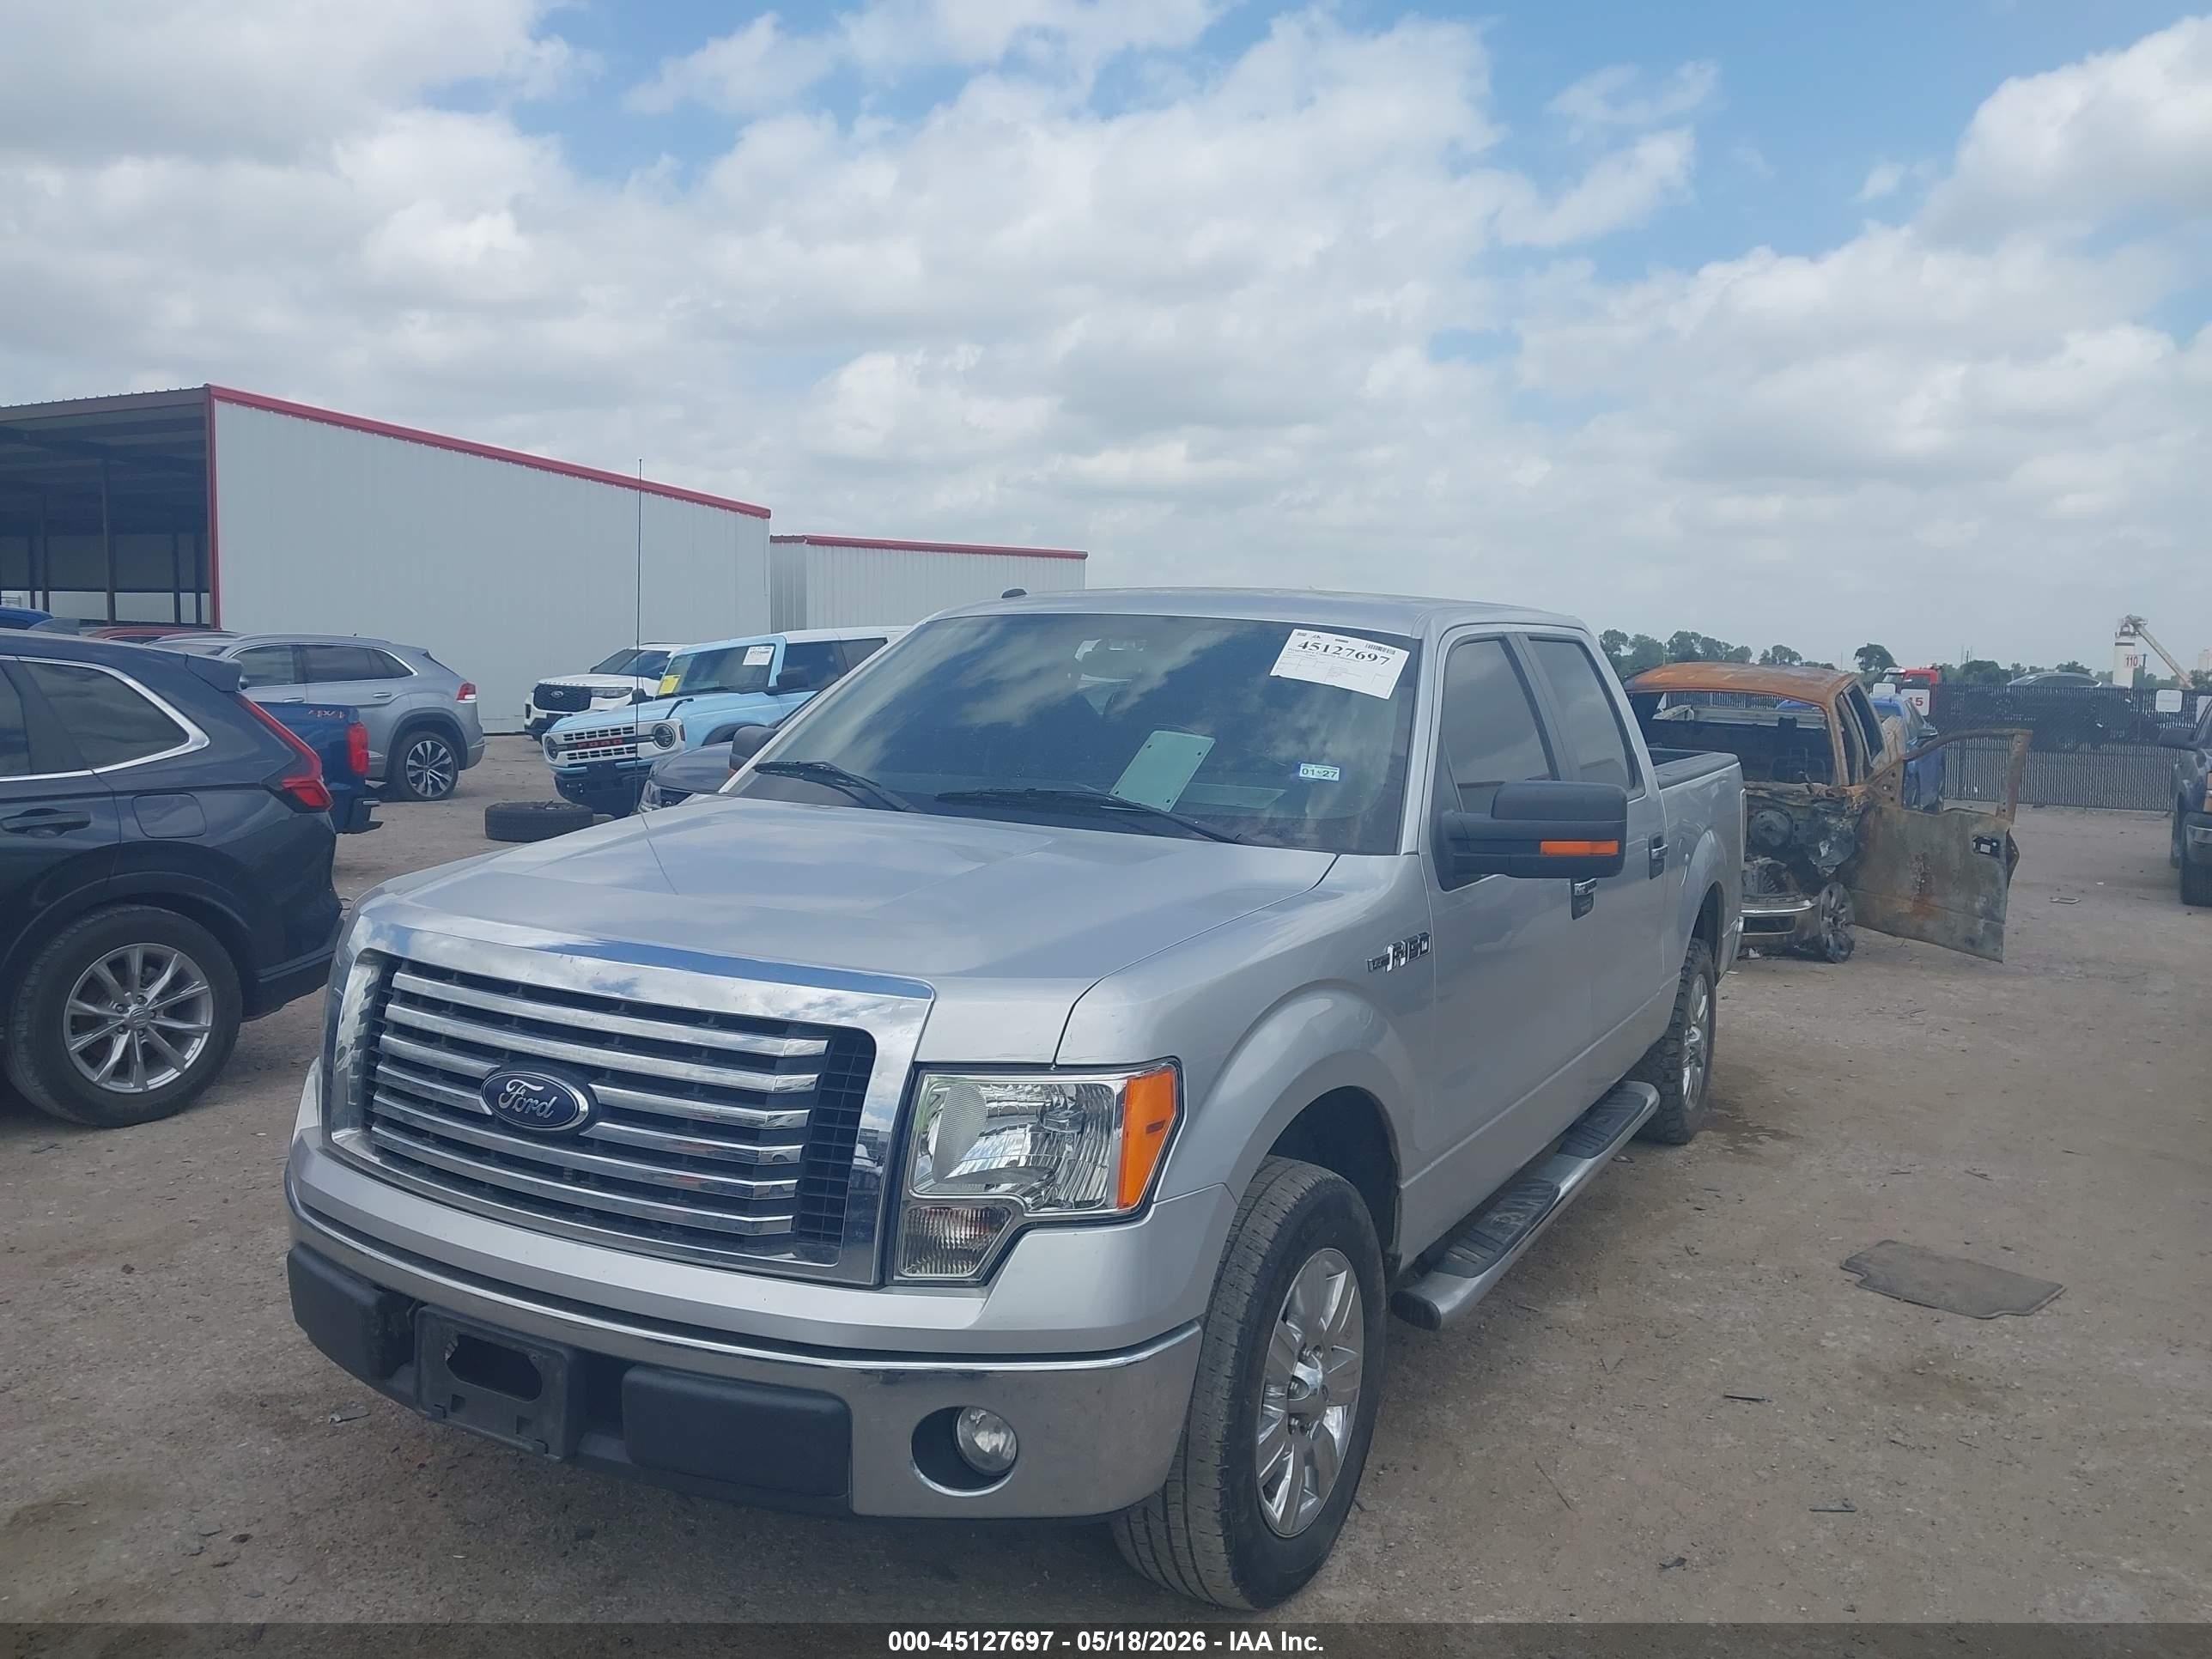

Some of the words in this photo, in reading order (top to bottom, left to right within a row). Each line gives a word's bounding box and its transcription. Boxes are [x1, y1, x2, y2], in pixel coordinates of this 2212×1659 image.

[1297, 640, 1391, 665] 45127697
[2126, 656, 2138, 667] 110
[1302, 768, 1315, 776] 01
[1322, 769, 1338, 778] 27
[498, 1079, 558, 1119] Ford
